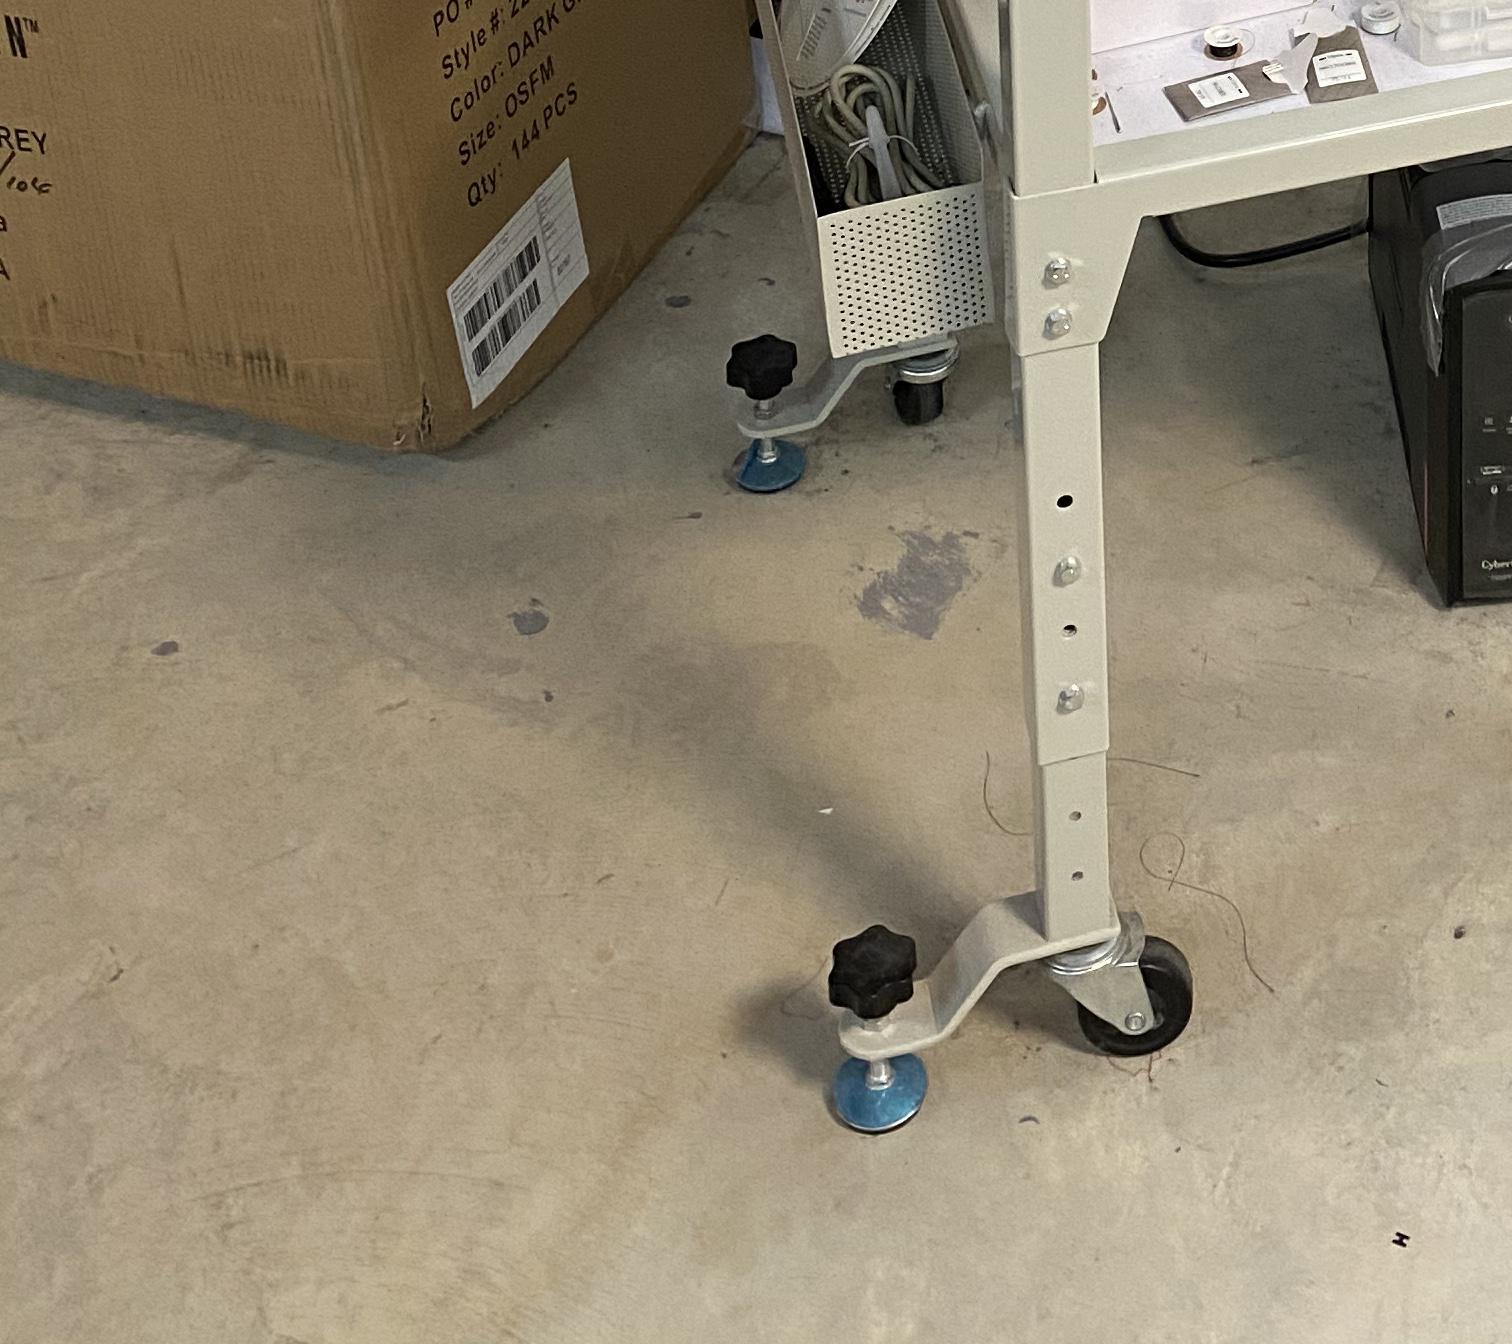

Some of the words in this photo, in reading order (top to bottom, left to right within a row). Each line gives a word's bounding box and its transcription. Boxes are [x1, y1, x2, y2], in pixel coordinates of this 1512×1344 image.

[441, 27, 487, 80] Style
[450, 61, 505, 123] Color:
[507, 3, 560, 69] DARK
[458, 114, 502, 166] Size:
[504, 55, 556, 118] OSFM
[467, 161, 503, 208] Qty:
[510, 119, 541, 161] 144
[543, 82, 578, 130] PCS
